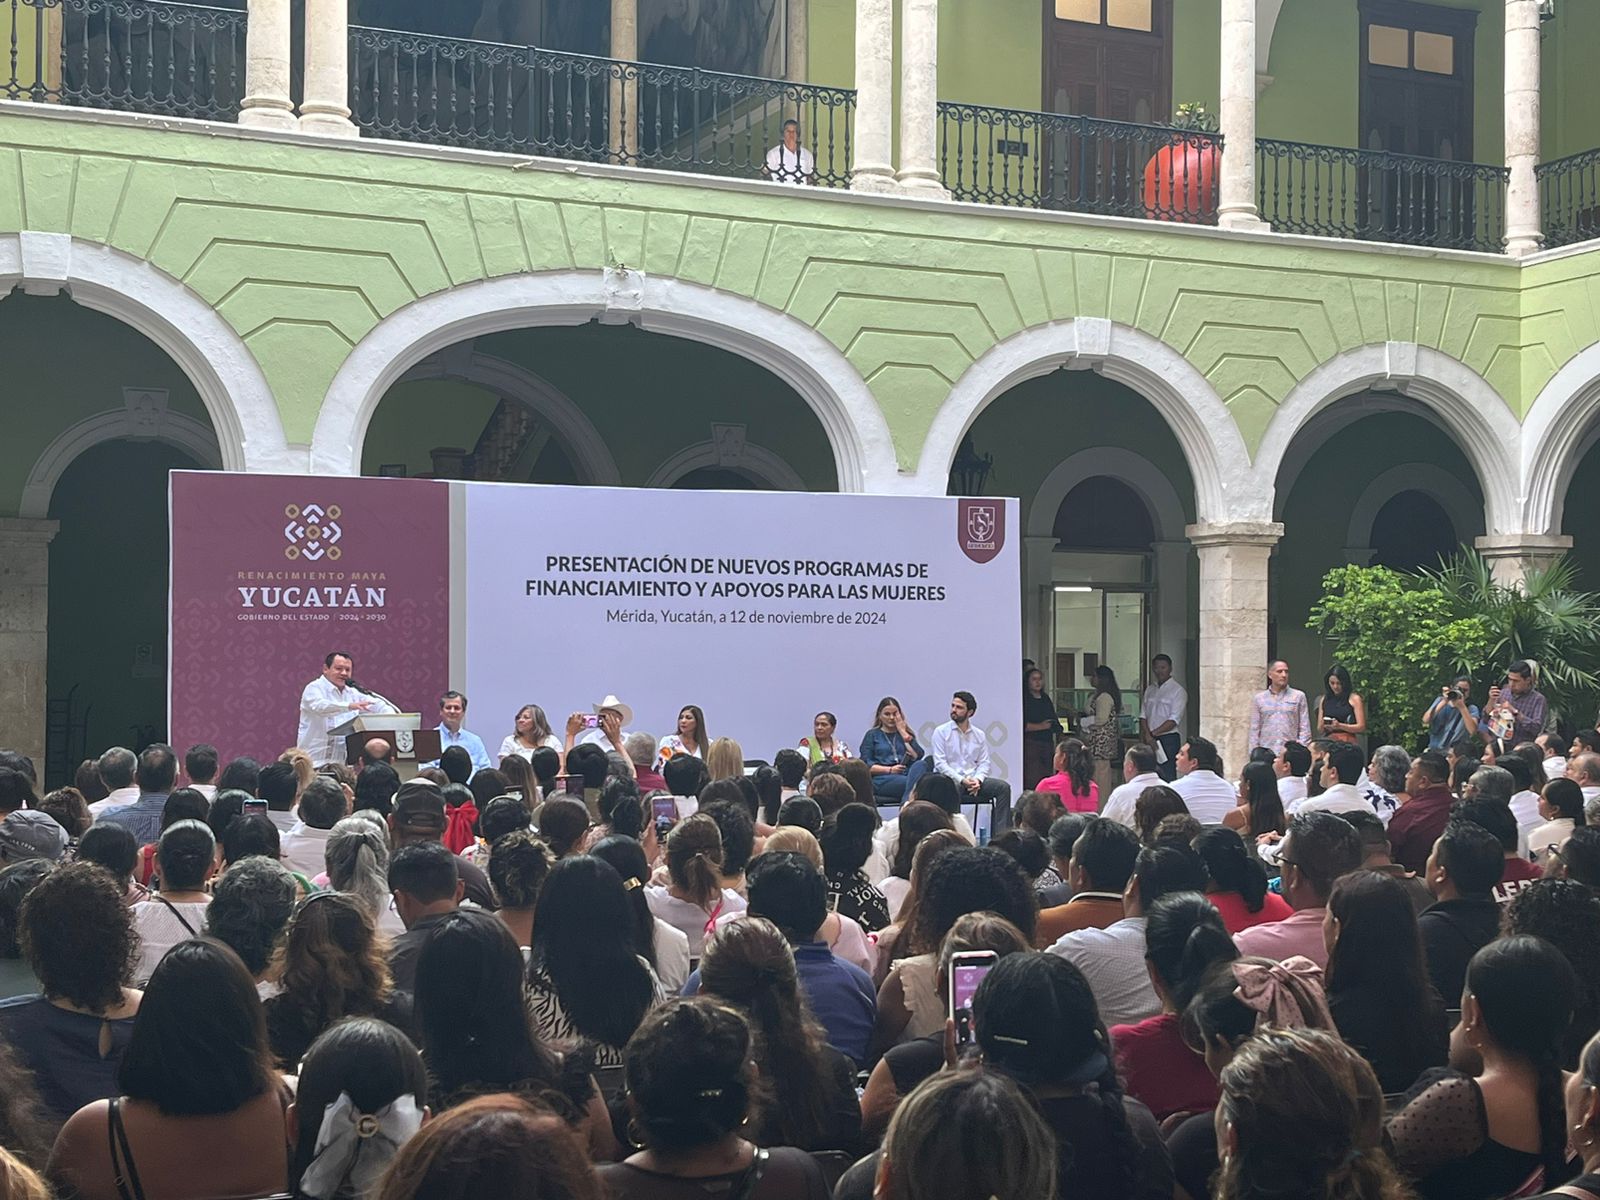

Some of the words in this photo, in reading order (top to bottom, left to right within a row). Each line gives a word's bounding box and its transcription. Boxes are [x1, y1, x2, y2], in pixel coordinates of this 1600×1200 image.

[546, 553, 687, 574] PRESENTACIÓN
[690, 557, 715, 574] DE
[717, 558, 791, 576] NUEVOS
[794, 560, 904, 578] PROGRAMAS
[906, 563, 929, 579] DE
[237, 571, 345, 581] RENACIMIENTO
[351, 572, 386, 581] MAYA
[237, 583, 387, 608] YUCATÁN
[525, 579, 692, 597] FINANCIAMIENTO
[694, 581, 708, 598] Y
[710, 581, 785, 598] APOYOS
[787, 582, 835, 600] PARA
[837, 583, 869, 600] LAS
[871, 584, 946, 601] MUJERES
[237, 613, 281, 621] GOBIERNO
[281, 613, 298, 621] DEL
[299, 613, 330, 621] ESTADO
[606, 609, 658, 625] Mérida,
[660, 609, 717, 625] Yucatán,
[718, 613, 727, 623] a
[730, 609, 746, 624] 12
[748, 609, 765, 624] de
[767, 610, 835, 625] noviembre
[836, 611, 852, 625] de
[854, 611, 887, 625] 2024
